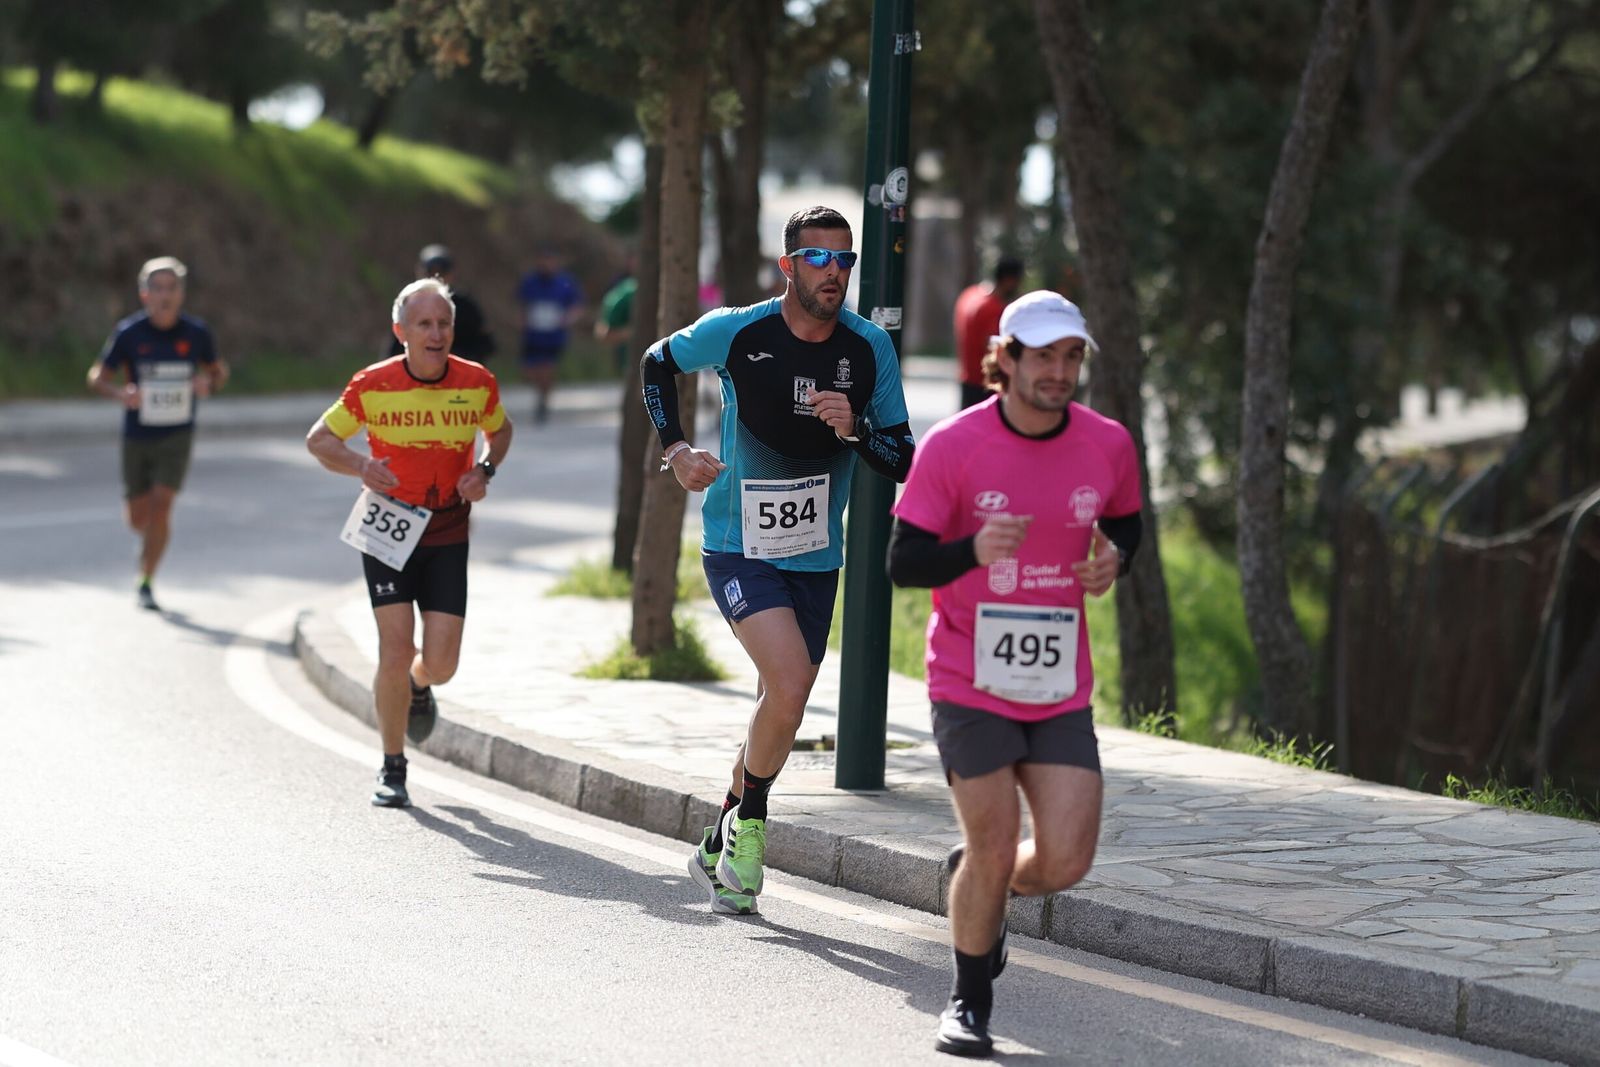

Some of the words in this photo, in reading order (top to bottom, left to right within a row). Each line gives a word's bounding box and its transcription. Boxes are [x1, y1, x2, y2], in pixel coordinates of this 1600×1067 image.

[645, 384, 668, 429] ATLETISMO
[361, 502, 412, 543] 358
[758, 496, 818, 530] 584
[1021, 564, 1061, 577] Ciudad
[1021, 578, 1036, 589] de
[993, 632, 1061, 669] 495
